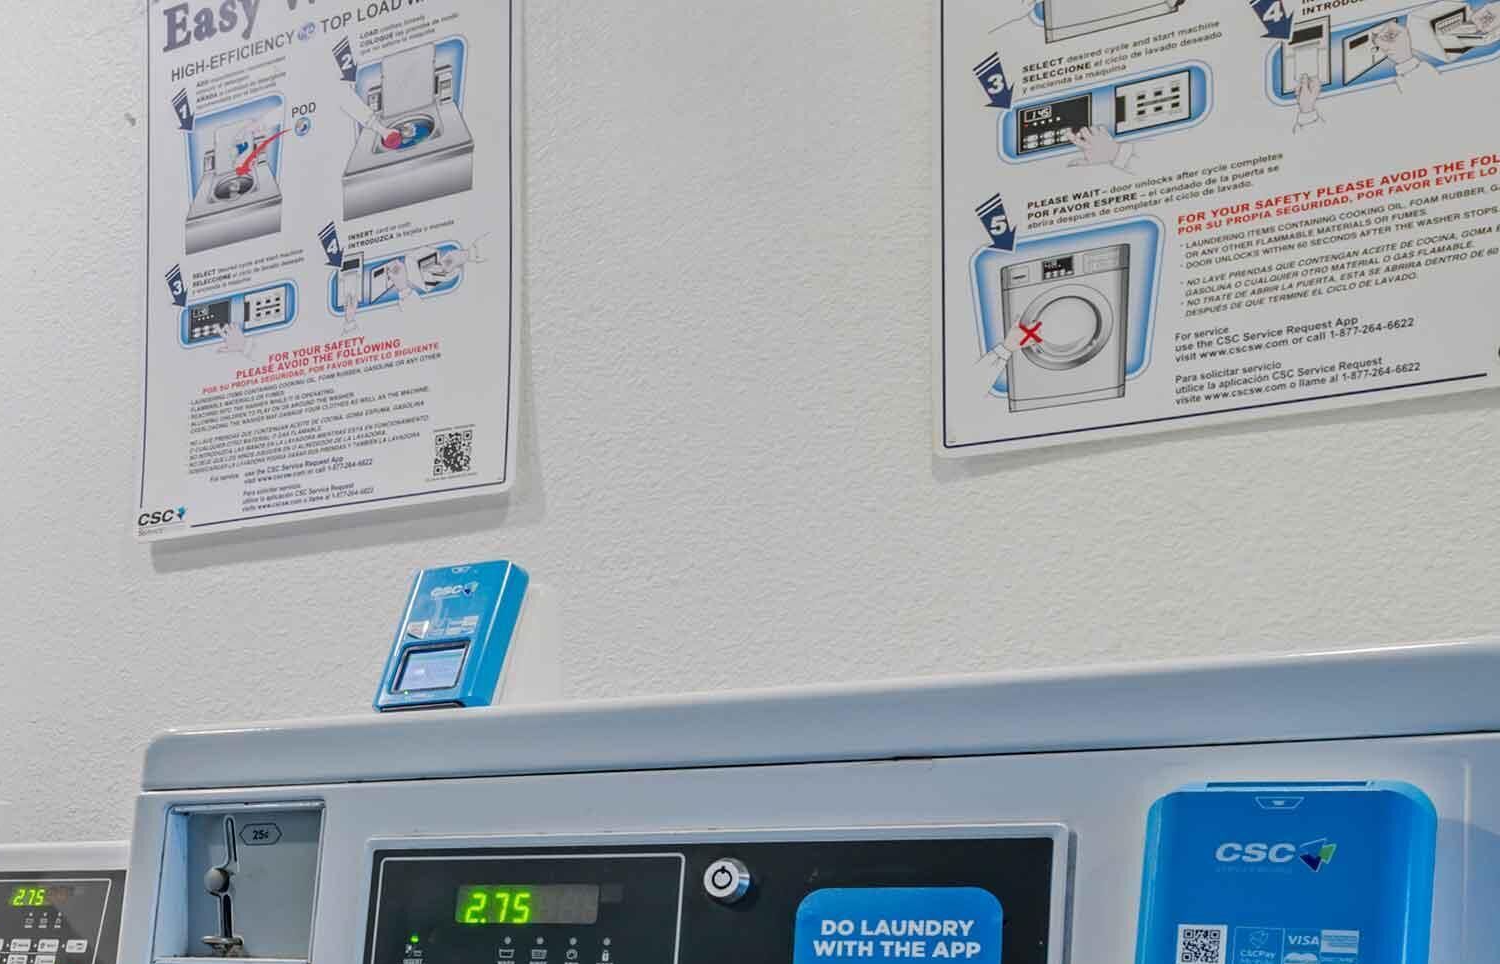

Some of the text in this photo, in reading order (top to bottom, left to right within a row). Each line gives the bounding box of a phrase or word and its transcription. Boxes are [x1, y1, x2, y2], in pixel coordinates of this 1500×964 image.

[1263, 0, 1284, 22] 4
[171, 30, 295, 82] HIGH-EFFICIENCY
[320, 12, 352, 33] TOP
[341, 54, 351, 70] 2
[1022, 57, 1065, 73] SELECT
[1022, 61, 1092, 84] SELECCIONE
[987, 74, 1004, 95] 3
[180, 106, 189, 121] 1
[291, 101, 317, 119] POD
[1027, 188, 1101, 209] PLEASE WAIT
[1178, 211, 1206, 225] FOR
[1211, 203, 1250, 218] YOUR
[1255, 190, 1312, 210] SAFETY
[1316, 178, 1375, 198] PLEASE
[1380, 168, 1428, 186] AVOID
[1433, 160, 1466, 175] THE
[1178, 221, 1203, 236] POR
[1205, 220, 1223, 231] SU
[1226, 209, 1272, 227] PROPIA
[1357, 188, 1383, 201] POR
[1388, 180, 1431, 195] FAVOR
[1435, 170, 1476, 186] EVITE
[1480, 166, 1498, 178] LO
[1027, 192, 1138, 221] POR FAVOR ESPERE
[990, 215, 1007, 236] 5
[327, 238, 338, 254] 4
[172, 281, 182, 296] 3
[1175, 325, 1229, 342] For service
[1175, 316, 1358, 352] use the CSC Service Request App
[1175, 351, 1197, 363] visit
[1292, 336, 1303, 345] or
[1307, 330, 1326, 343] call
[1330, 317, 1415, 339] 1-877-264-6622
[236, 338, 402, 380] PLEASE AVOID THE FOLLOWING
[268, 336, 365, 363] FOR YOUR SAFETY
[137, 508, 174, 527] CSC
[1215, 843, 1296, 863] CSC
[464, 892, 532, 924] 2.75
[820, 919, 975, 937] DO LAUNDRY
[813, 939, 981, 959] WITH THE APP
[1288, 935, 1319, 946] VISA
